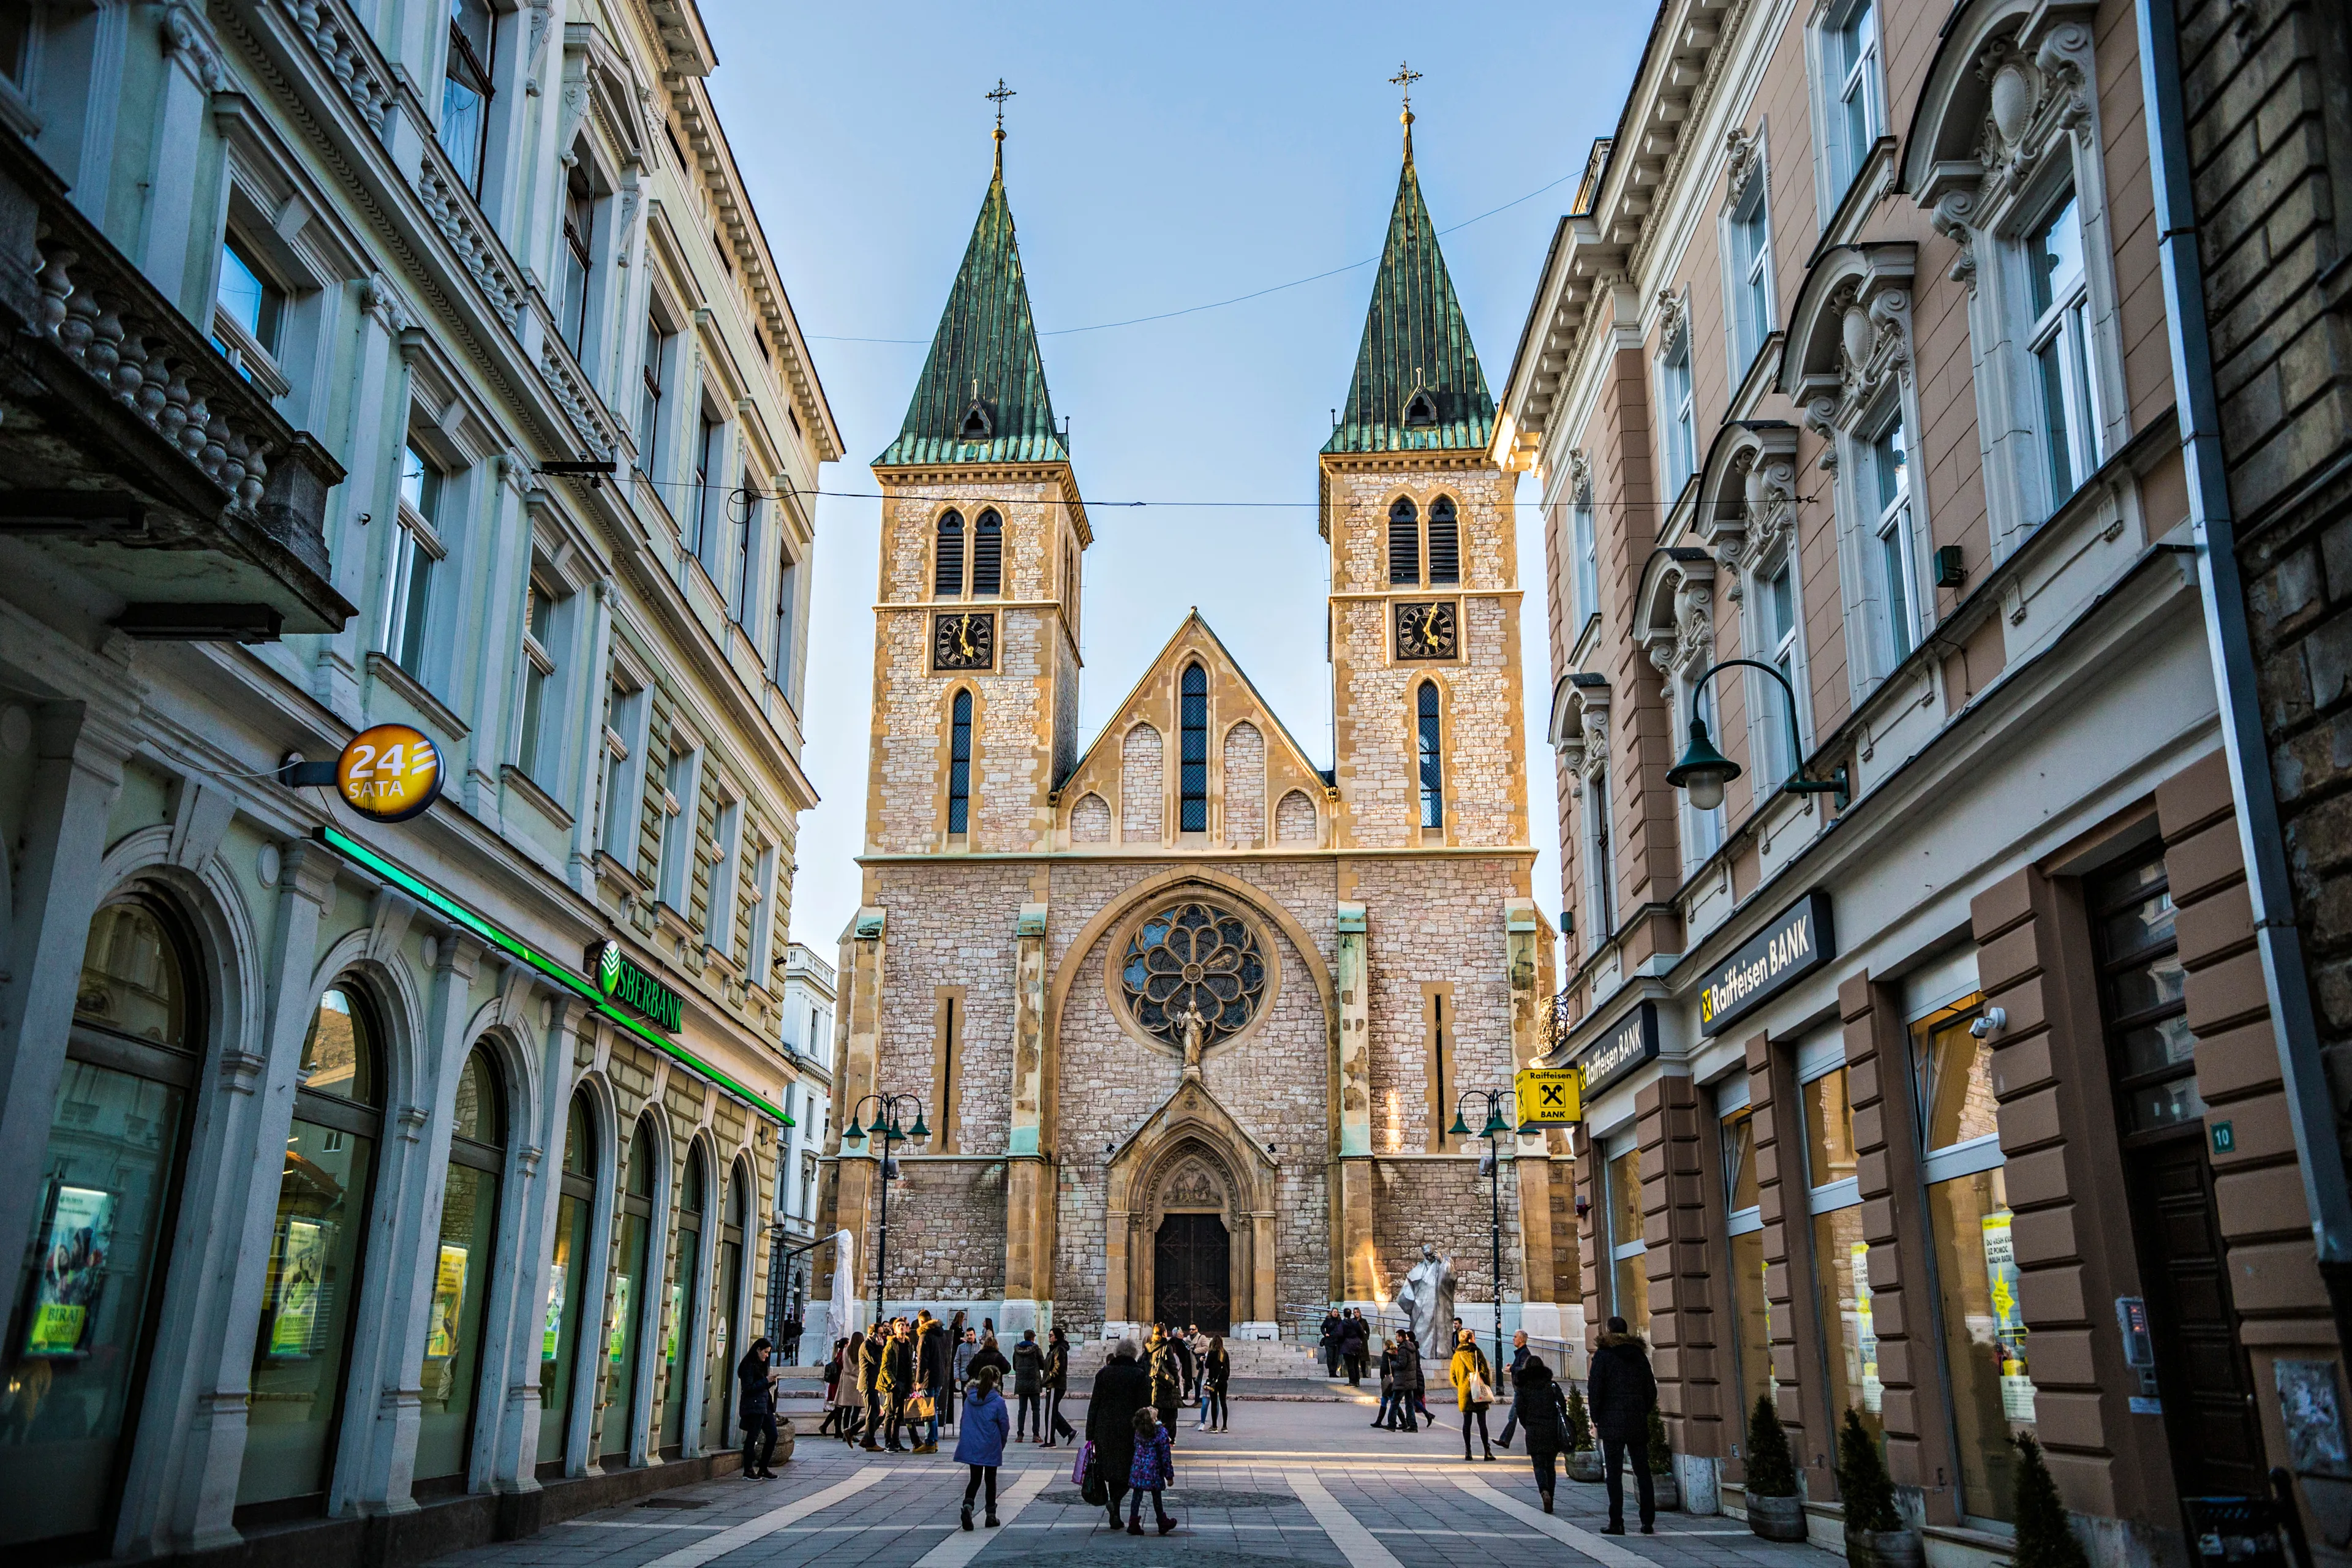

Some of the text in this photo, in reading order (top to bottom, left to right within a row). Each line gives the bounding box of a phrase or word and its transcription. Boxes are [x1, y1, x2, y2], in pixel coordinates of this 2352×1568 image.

[349, 743, 405, 779] 24
[348, 780, 405, 799] SATA
[1711, 914, 1809, 1016] Raiffeisen BANK
[617, 960, 684, 1034] SBERBANK
[1585, 1020, 1642, 1087] Raiffeisen BANK
[2215, 1129, 2229, 1146] 10
